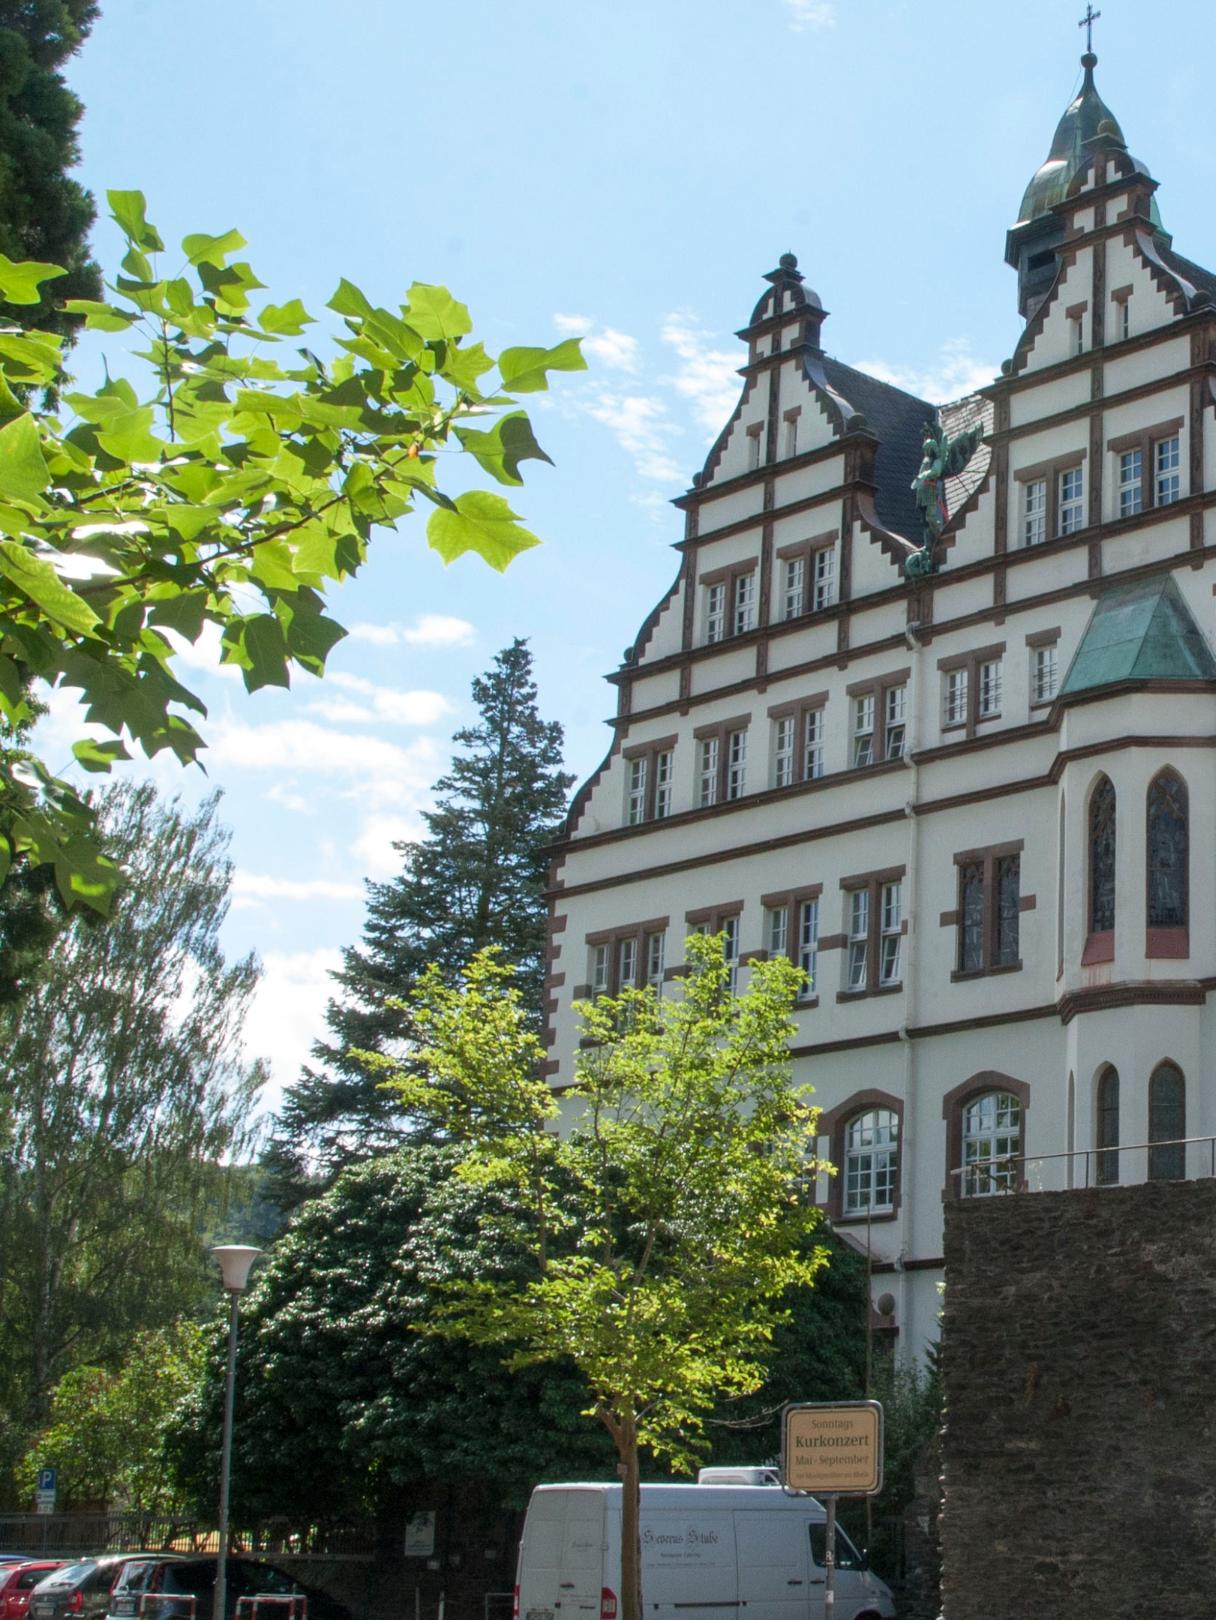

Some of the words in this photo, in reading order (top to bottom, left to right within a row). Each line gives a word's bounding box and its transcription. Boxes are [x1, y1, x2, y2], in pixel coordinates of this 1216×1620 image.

[812, 1419, 854, 1431] Sonntags
[796, 1435, 869, 1448] Kurkonzert
[42, 1471, 52, 1487] P
